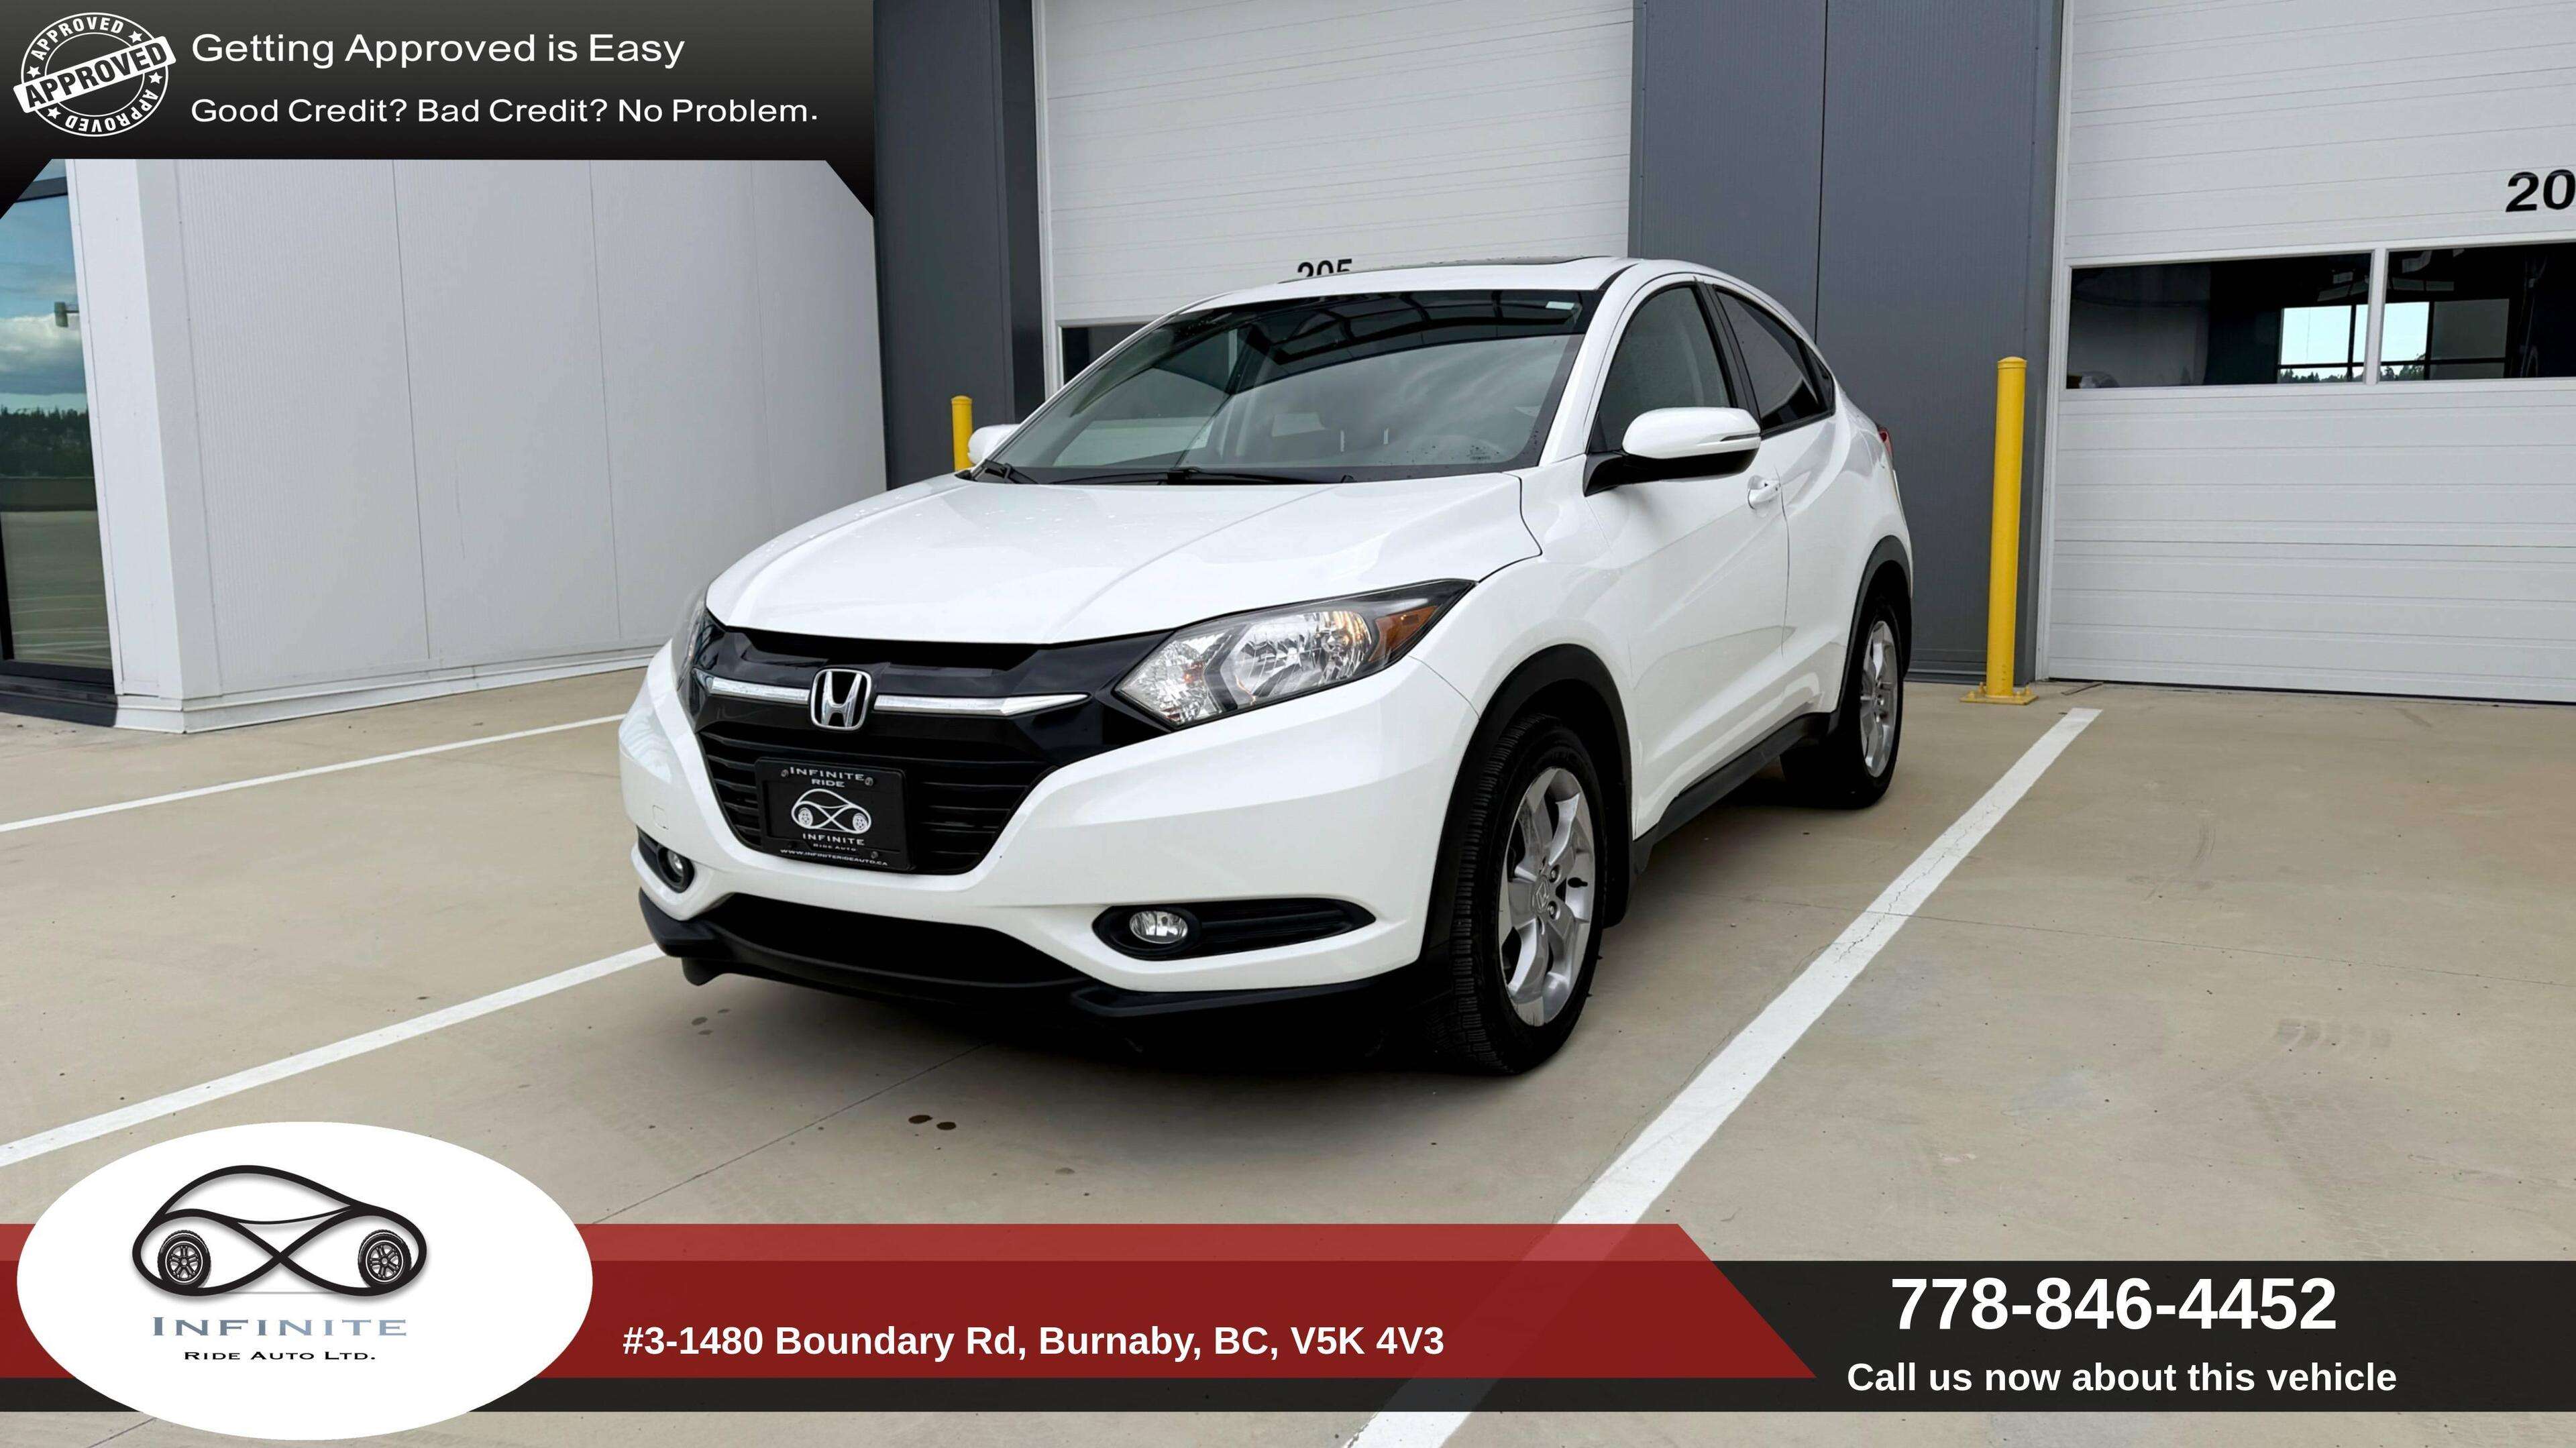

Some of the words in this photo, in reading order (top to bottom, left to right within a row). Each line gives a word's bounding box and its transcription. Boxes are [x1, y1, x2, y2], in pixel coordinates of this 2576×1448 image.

[790, 767, 865, 781] INFINITE
[811, 779, 845, 787] RIDE
[802, 833, 865, 846] INFINITE
